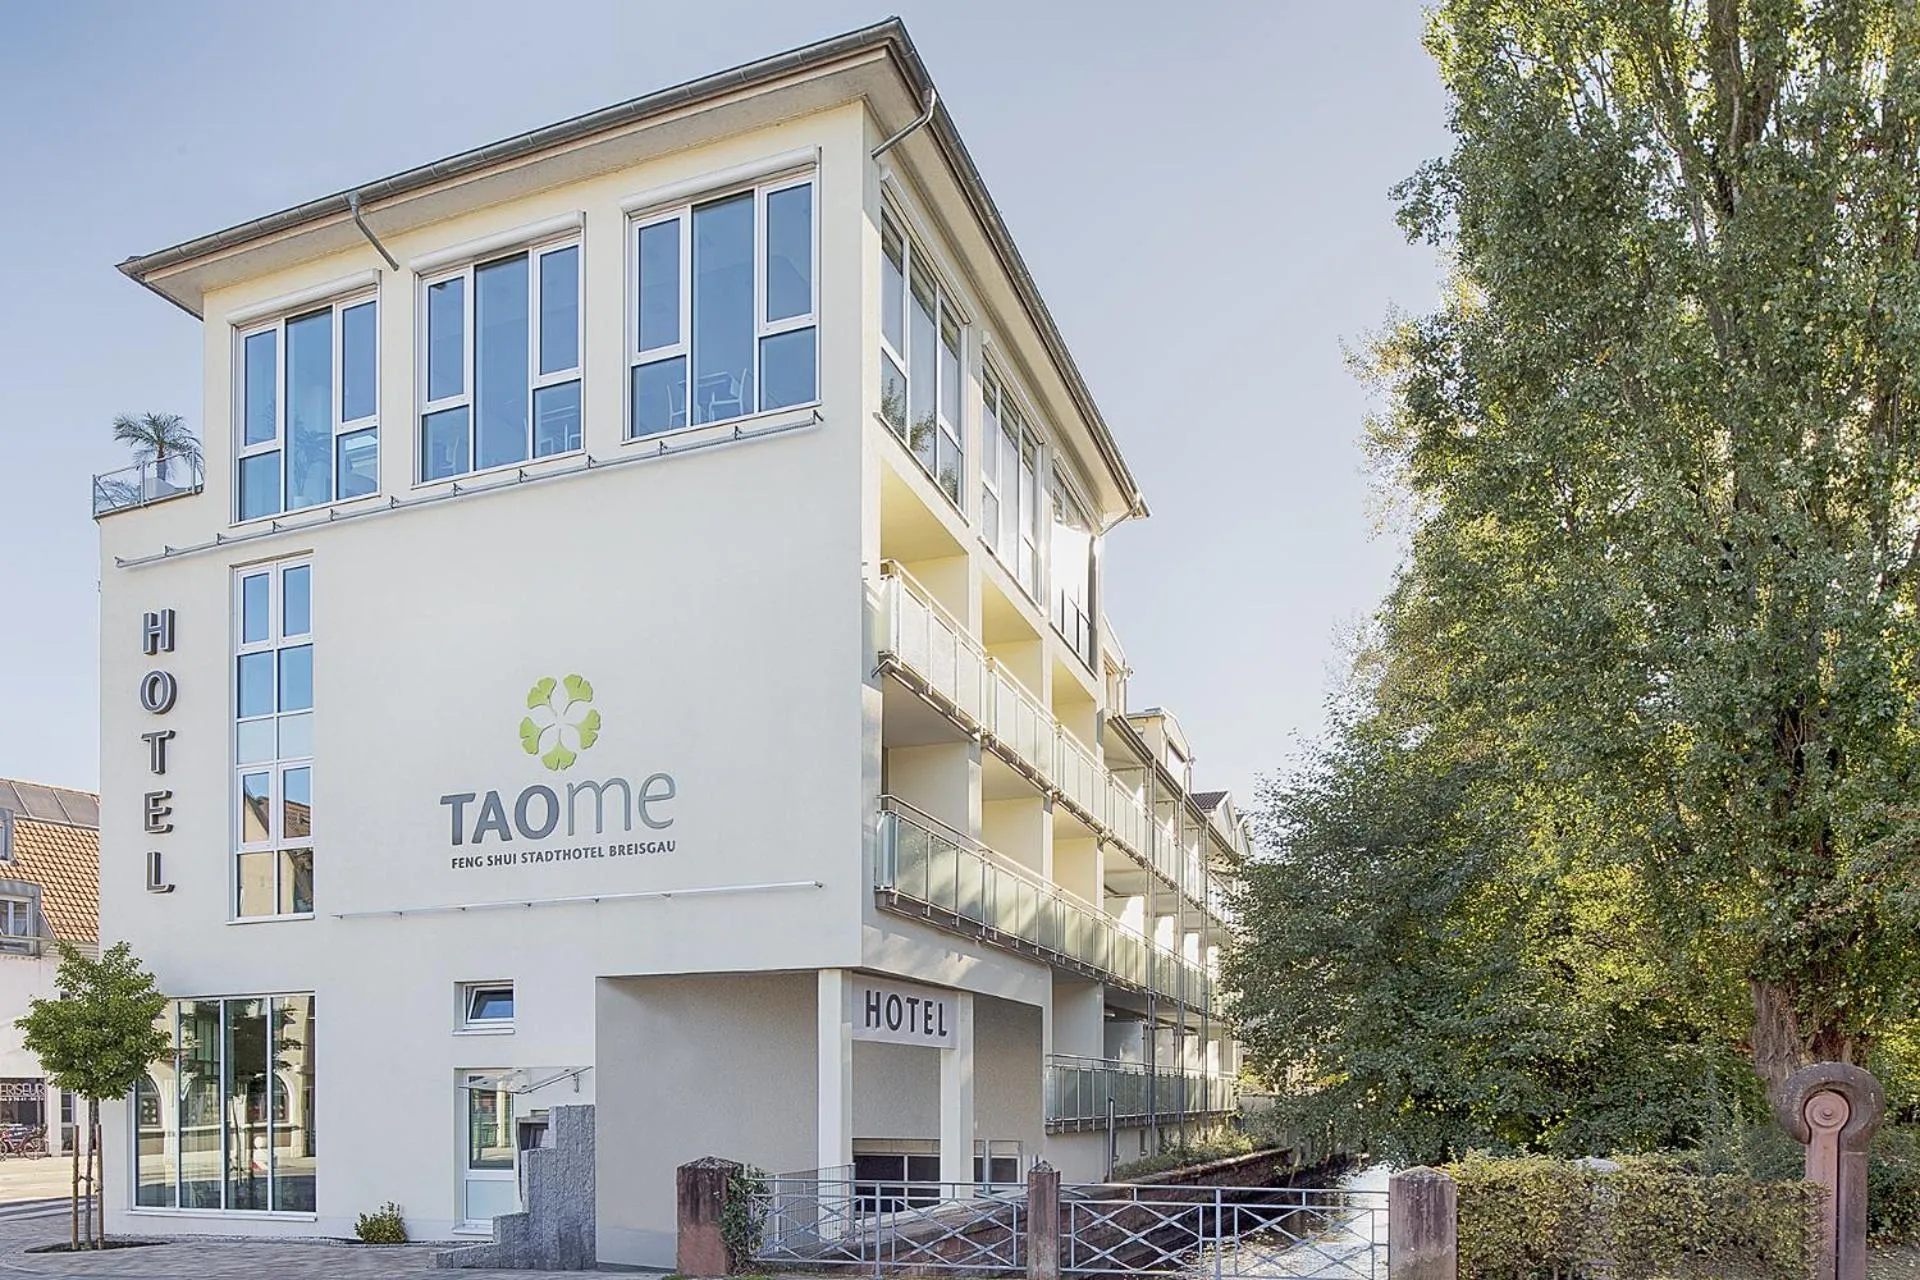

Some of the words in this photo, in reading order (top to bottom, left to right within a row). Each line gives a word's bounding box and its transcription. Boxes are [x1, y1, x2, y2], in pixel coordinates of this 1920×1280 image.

[140, 608, 177, 894] HOTEL
[440, 772, 676, 846] TAOme
[451, 856, 483, 869] FENG
[487, 853, 517, 866] SHUI
[521, 846, 604, 864] STADTHOTEL
[609, 840, 676, 857] BREISGAU
[865, 990, 947, 1037] HOTEL
